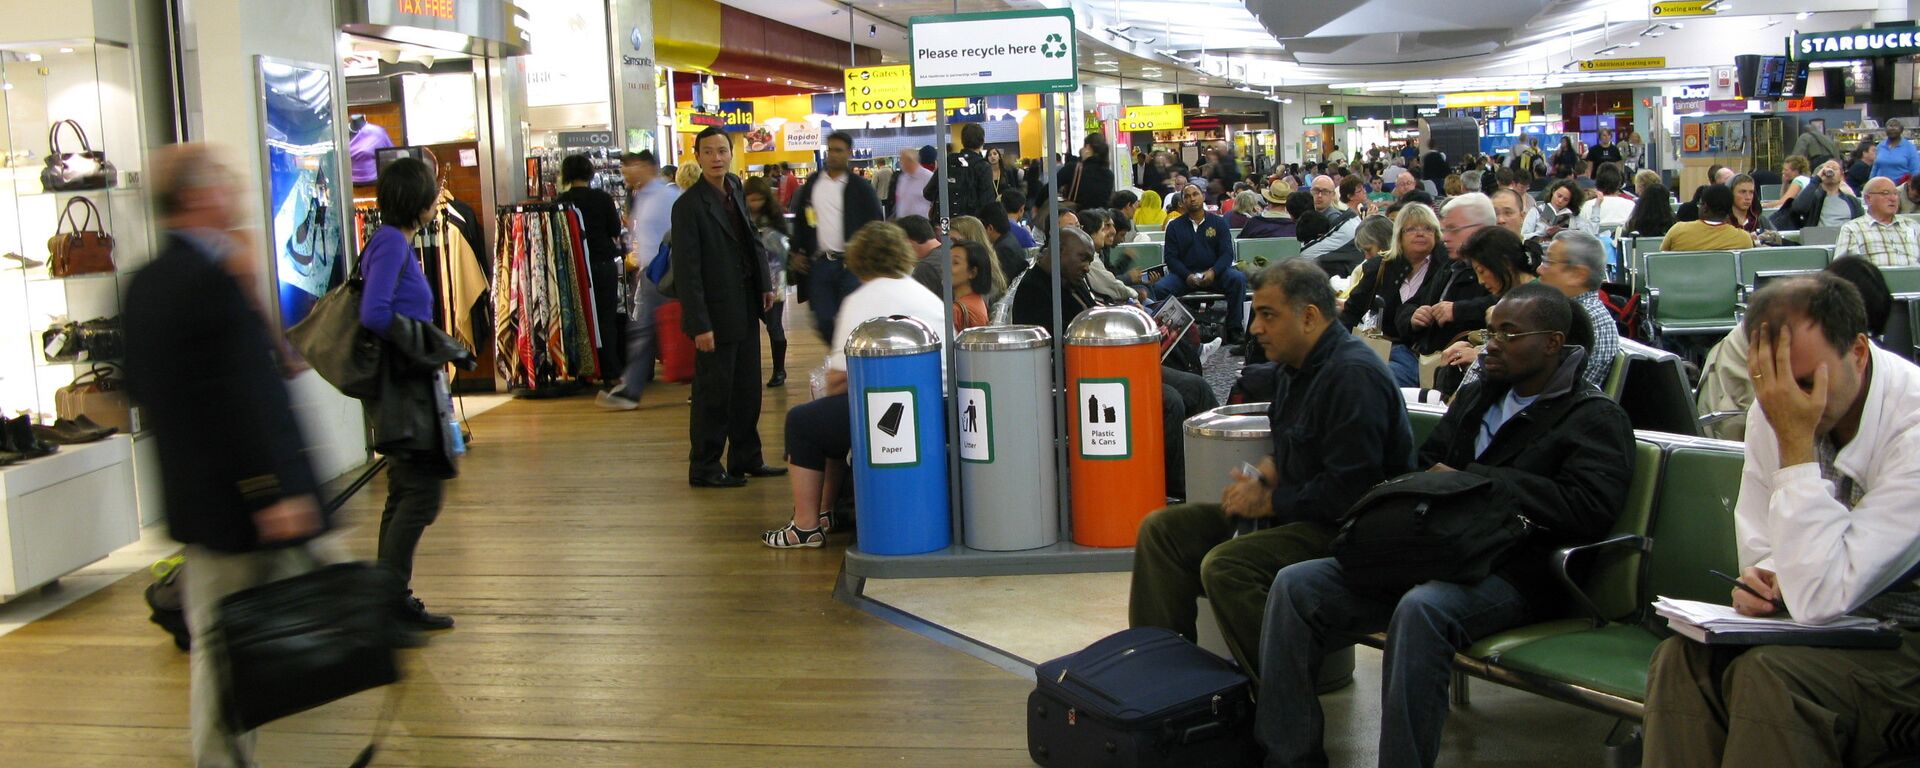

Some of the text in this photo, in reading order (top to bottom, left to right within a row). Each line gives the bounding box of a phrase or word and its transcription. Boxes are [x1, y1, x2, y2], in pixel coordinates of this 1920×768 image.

[398, 0, 454, 20] TAX FREE
[1801, 31, 1920, 53] STARBUCKS
[918, 44, 1037, 59] Please recycle here
[623, 54, 652, 67] Samsonite
[1594, 60, 1625, 68] Additional
[1626, 59, 1647, 67] seating
[872, 70, 898, 78] Gates
[787, 133, 819, 141] Rapido!
[1091, 429, 1116, 438] Plastic
[963, 440, 977, 449] Litter
[1091, 437, 1117, 446] & Cans
[881, 445, 903, 455] Paper
